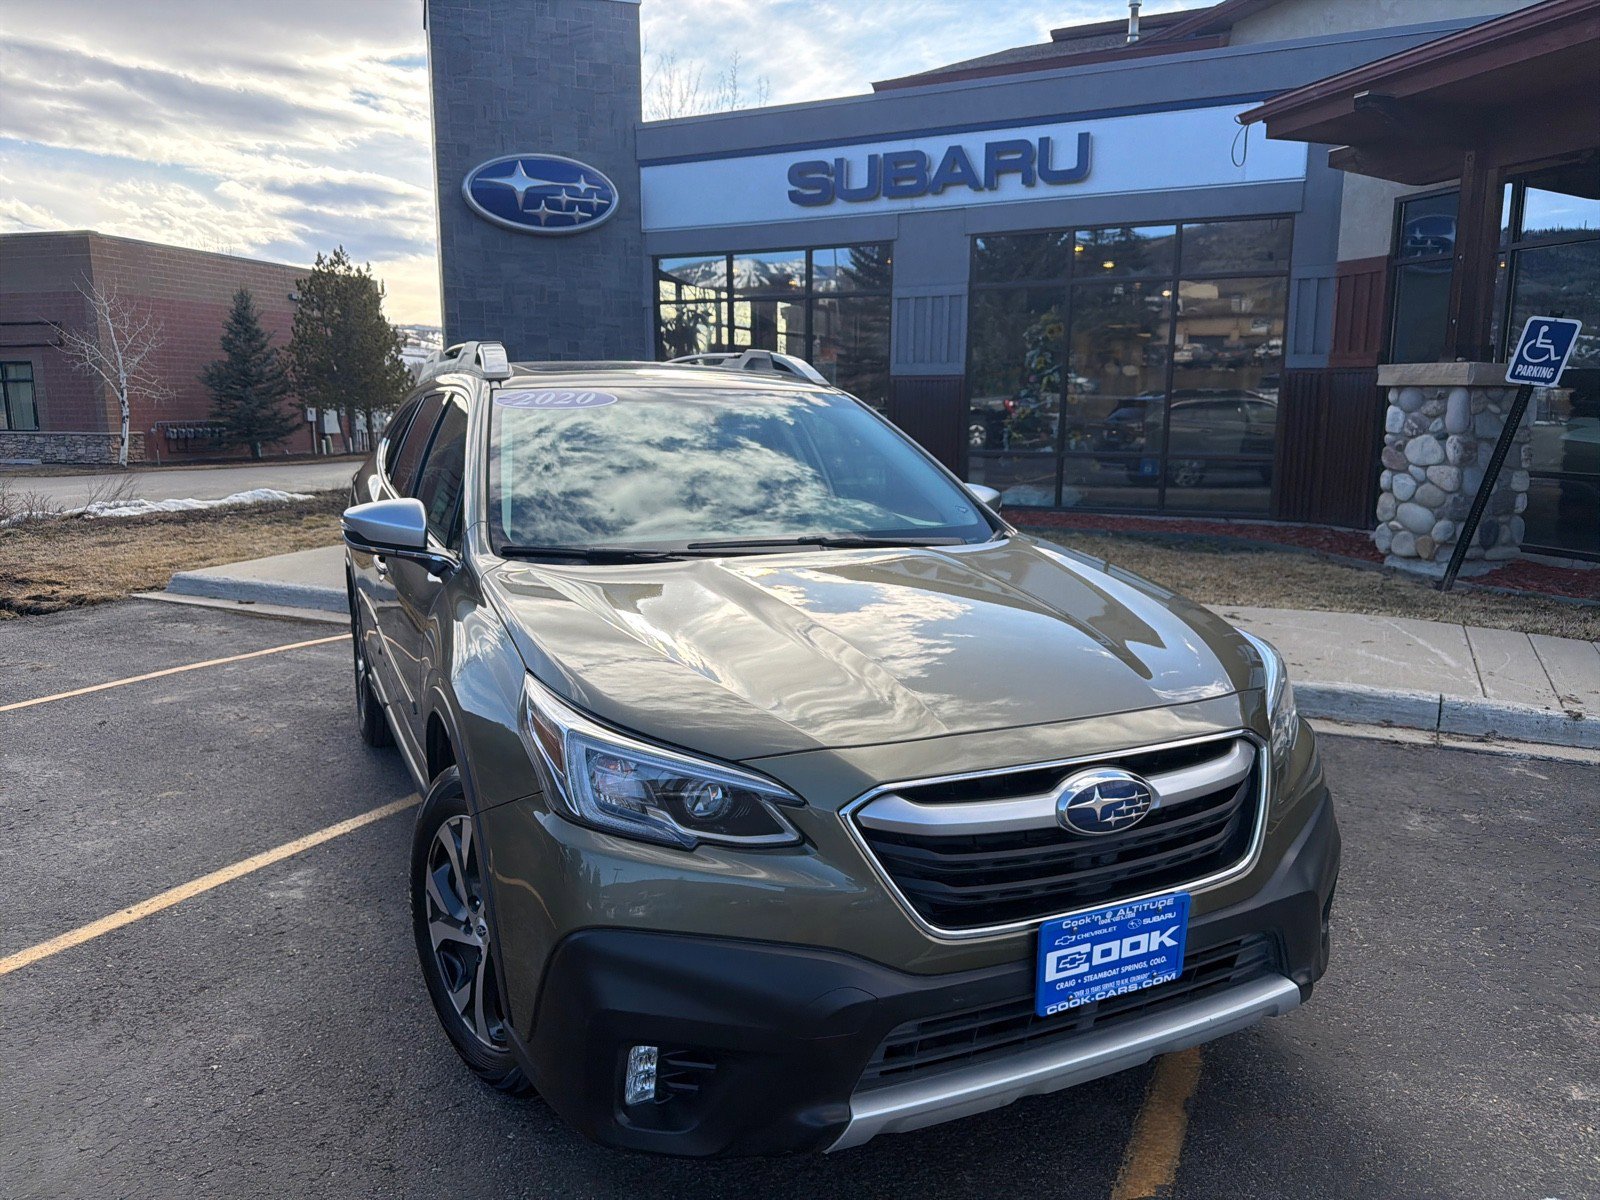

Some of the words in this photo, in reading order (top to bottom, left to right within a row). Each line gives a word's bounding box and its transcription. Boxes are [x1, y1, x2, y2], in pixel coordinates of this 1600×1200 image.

[787, 132, 1091, 207] SUBARU
[1515, 364, 1555, 379] PARKING
[512, 392, 596, 405] 2020
[1116, 897, 1175, 917] ALTITUDE
[1142, 911, 1177, 926] SUBARU
[1076, 925, 1118, 940] CHEVROLET
[1045, 925, 1181, 983] COOK
[1055, 978, 1076, 991] CRAIG
[1083, 967, 1120, 984] STEAMBOAT
[1120, 960, 1148, 975] SPRINGS,
[1149, 954, 1167, 967] COLO.
[1046, 973, 1177, 1016] COOK-CARS.COM
